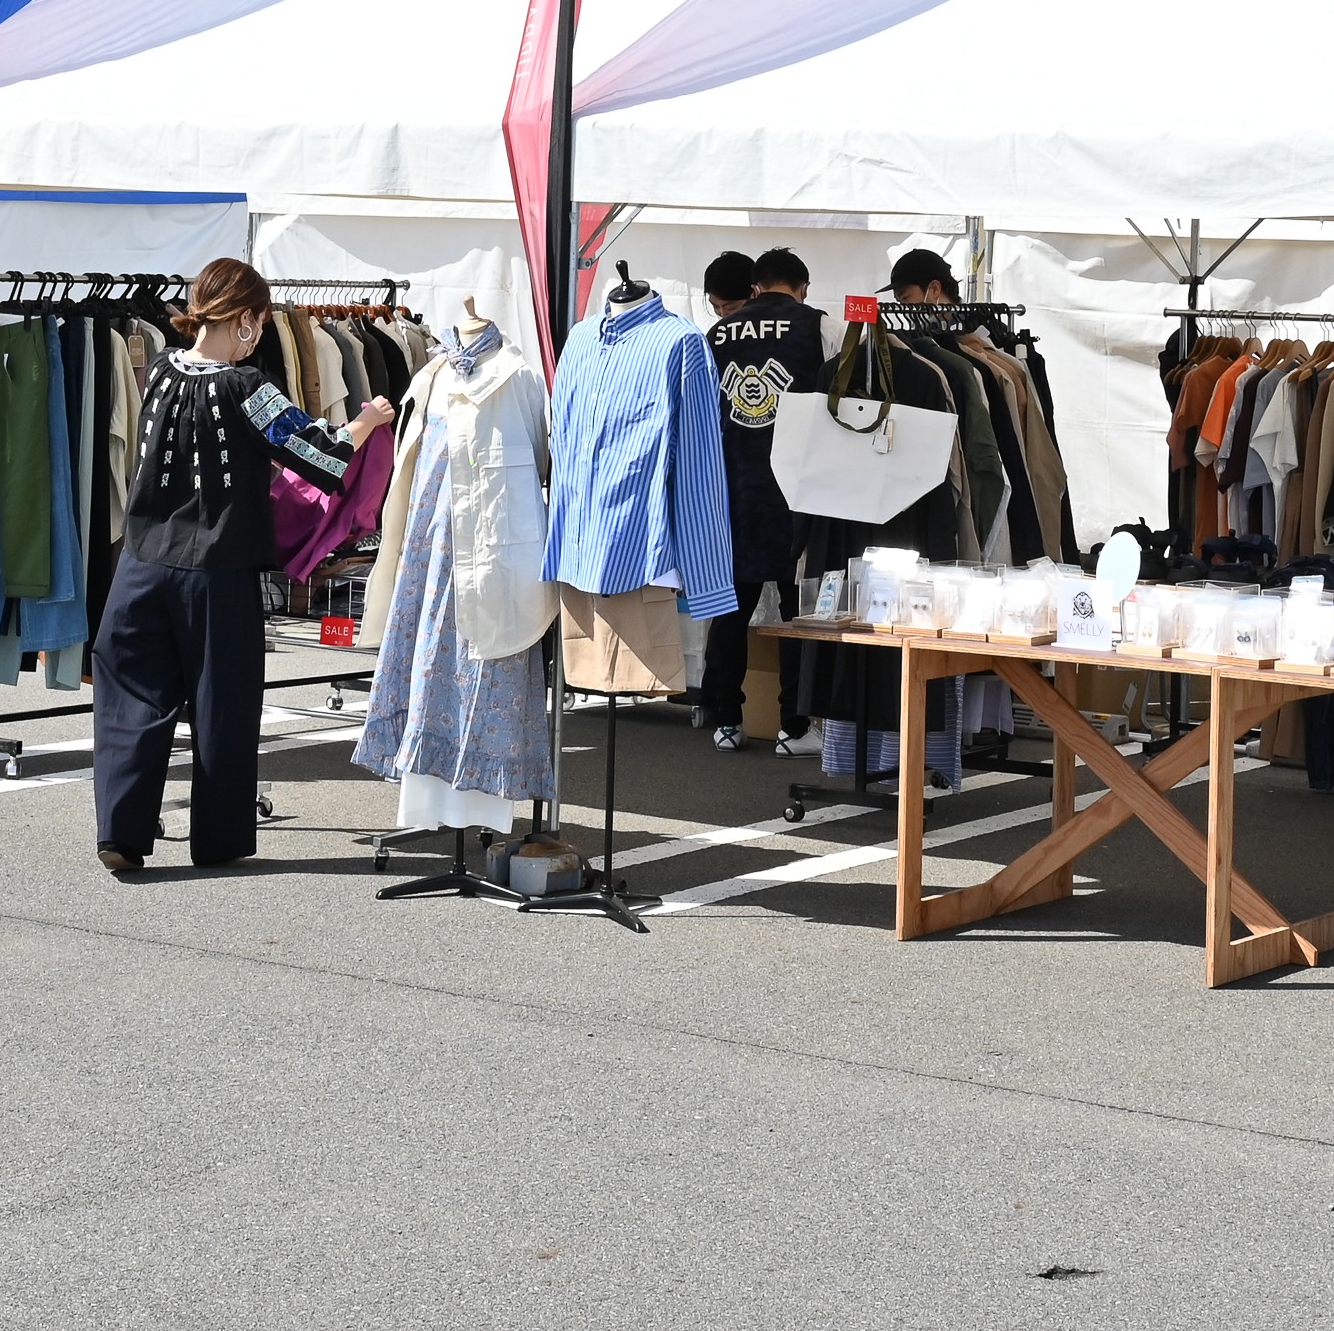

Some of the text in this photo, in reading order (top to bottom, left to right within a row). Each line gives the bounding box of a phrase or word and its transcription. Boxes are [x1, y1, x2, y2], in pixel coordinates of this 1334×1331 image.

[848, 302, 873, 313] SALE
[714, 319, 791, 346] STAFF
[324, 624, 349, 636] SALE
[1063, 621, 1105, 637] SMELLY
